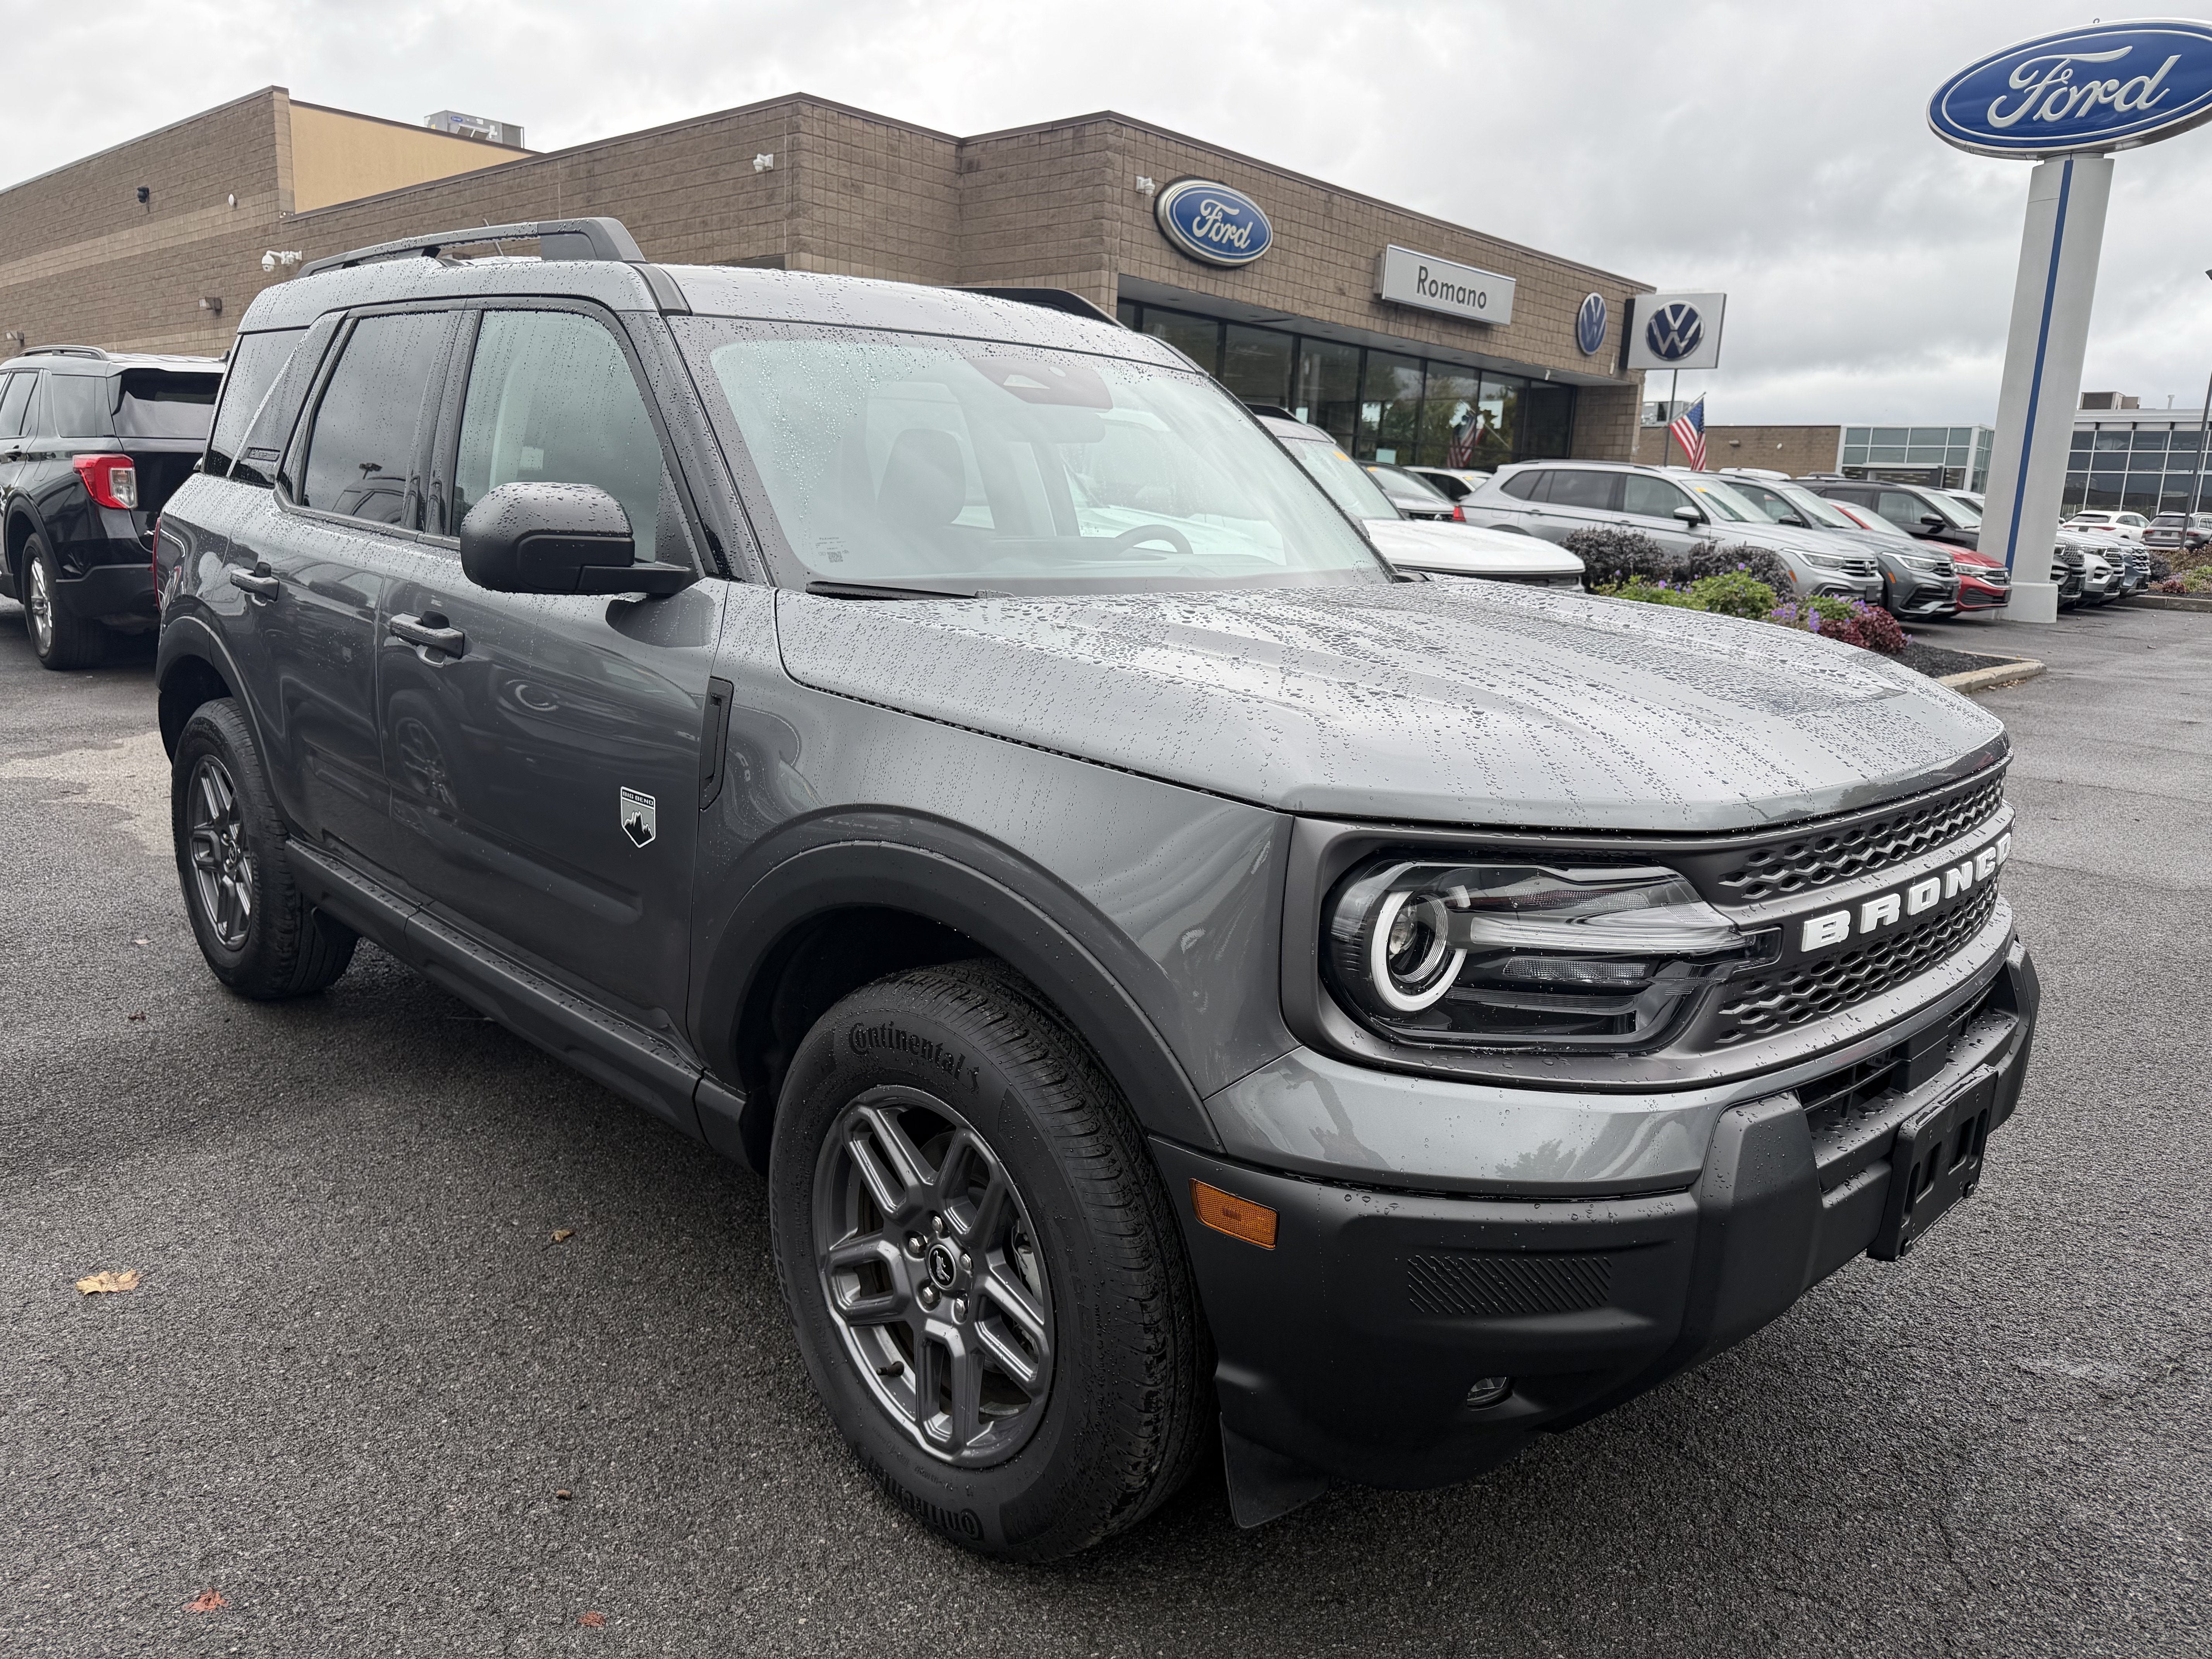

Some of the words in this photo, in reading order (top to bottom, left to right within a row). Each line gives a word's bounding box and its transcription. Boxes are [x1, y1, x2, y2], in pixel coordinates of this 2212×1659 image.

[1987, 45, 2182, 129] Ford
[1192, 199, 1254, 249] Ford
[1416, 265, 1487, 309] Romano
[1648, 302, 1704, 356] VW
[623, 791, 634, 799] BIG
[635, 795, 654, 805] BEND
[1801, 832, 2011, 952] BRONCO
[848, 1021, 966, 1081] Continental
